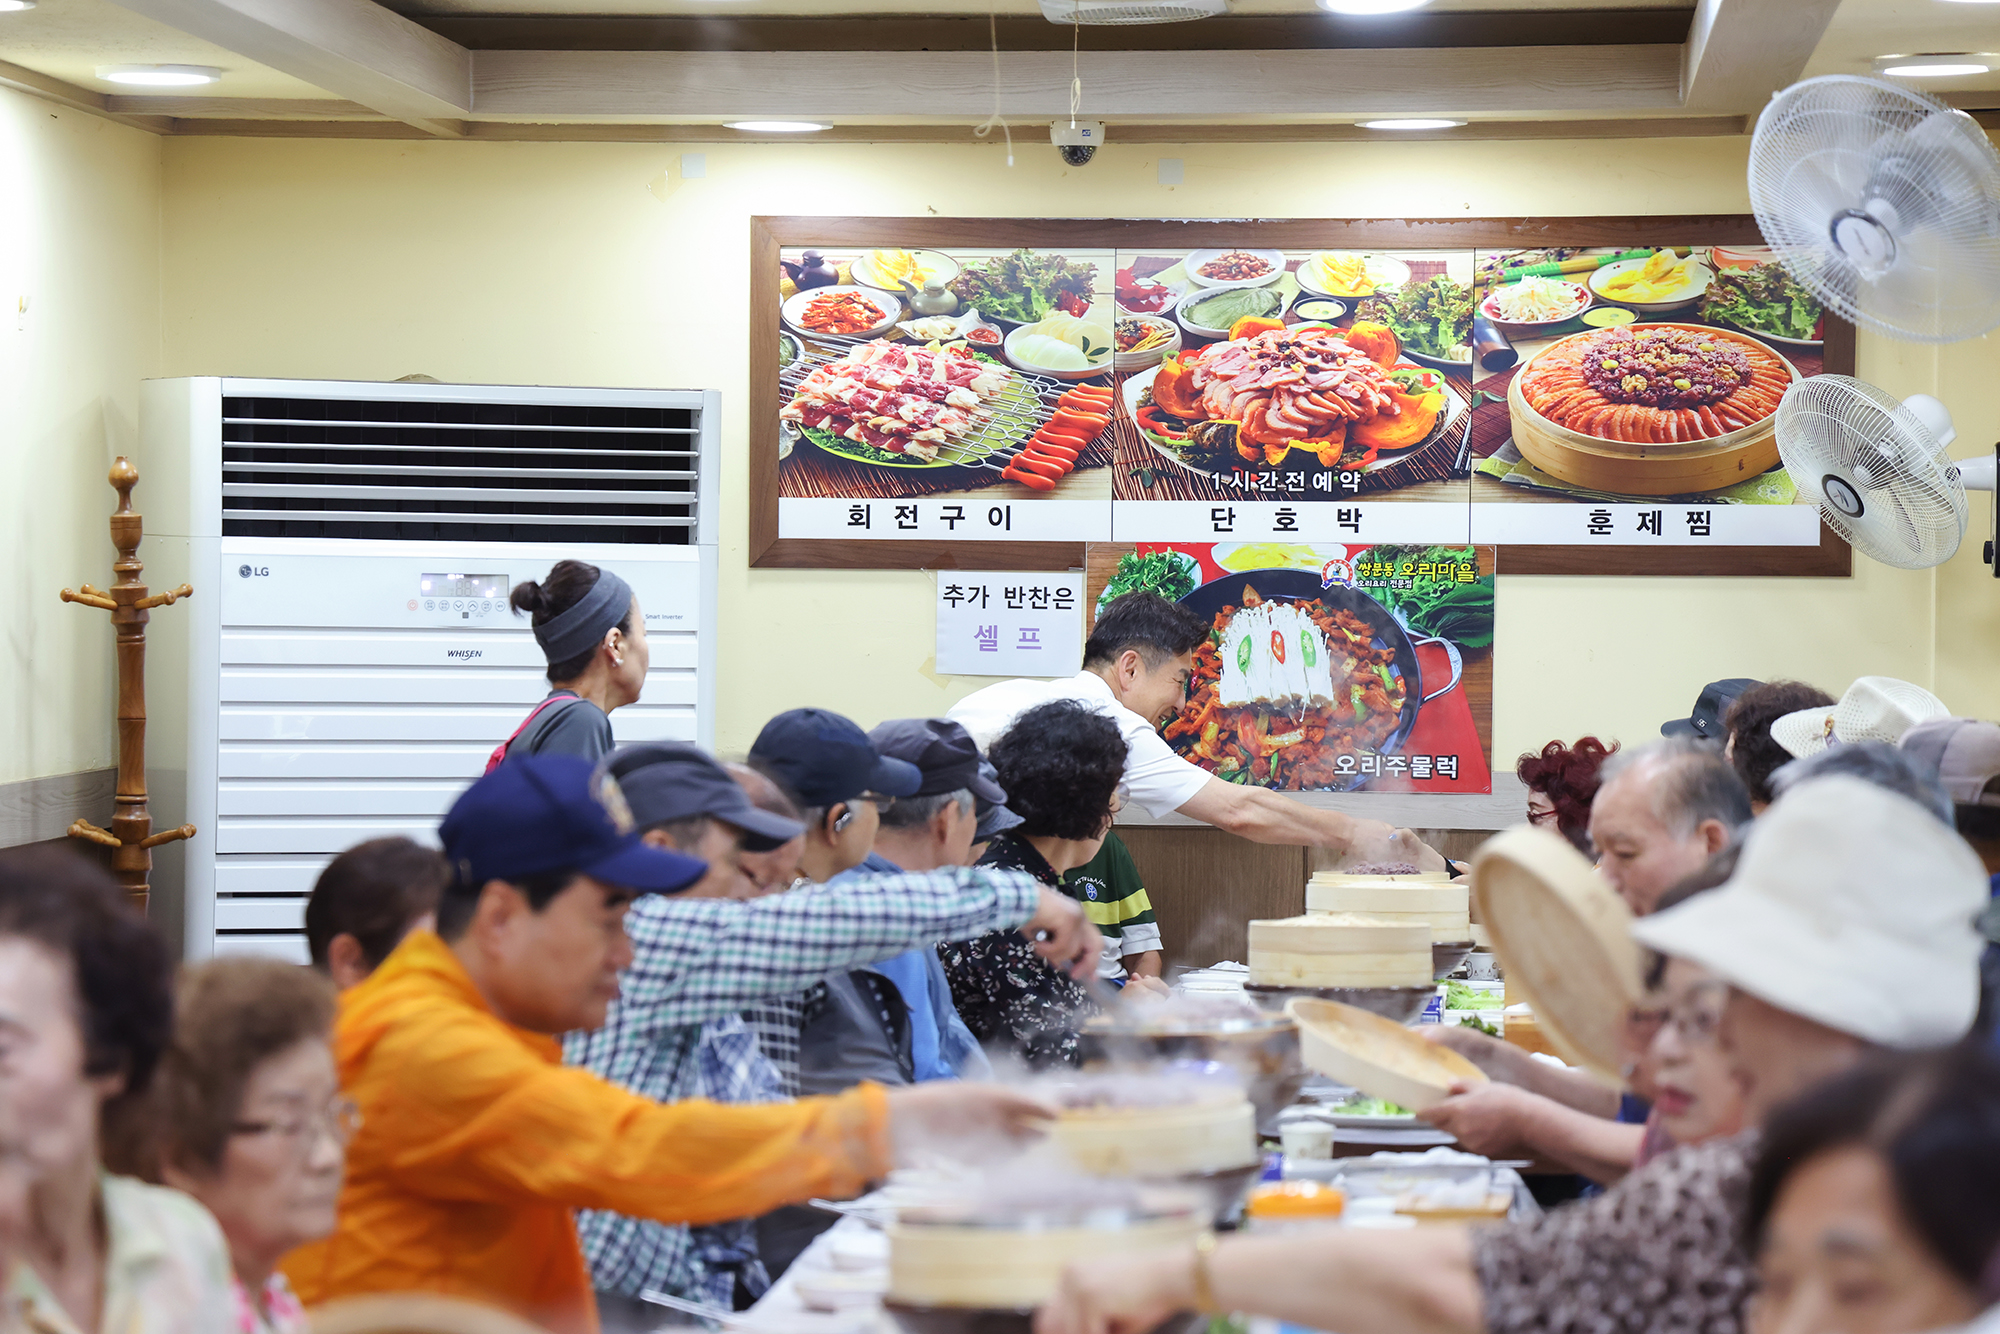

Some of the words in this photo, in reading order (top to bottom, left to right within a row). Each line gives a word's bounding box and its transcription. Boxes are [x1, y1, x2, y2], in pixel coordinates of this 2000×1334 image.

[1210, 471, 1362, 492] 1시간전예약
[254, 566, 270, 577] LG
[1357, 562, 1396, 578] 쌍문동
[1399, 562, 1476, 583] 오리마을
[1357, 579, 1388, 588] 오리요리
[942, 584, 990, 609] 추가
[1004, 586, 1075, 610] 반찬은
[447, 650, 483, 661] WHISEN
[1333, 754, 1458, 779] 오리주물럭
